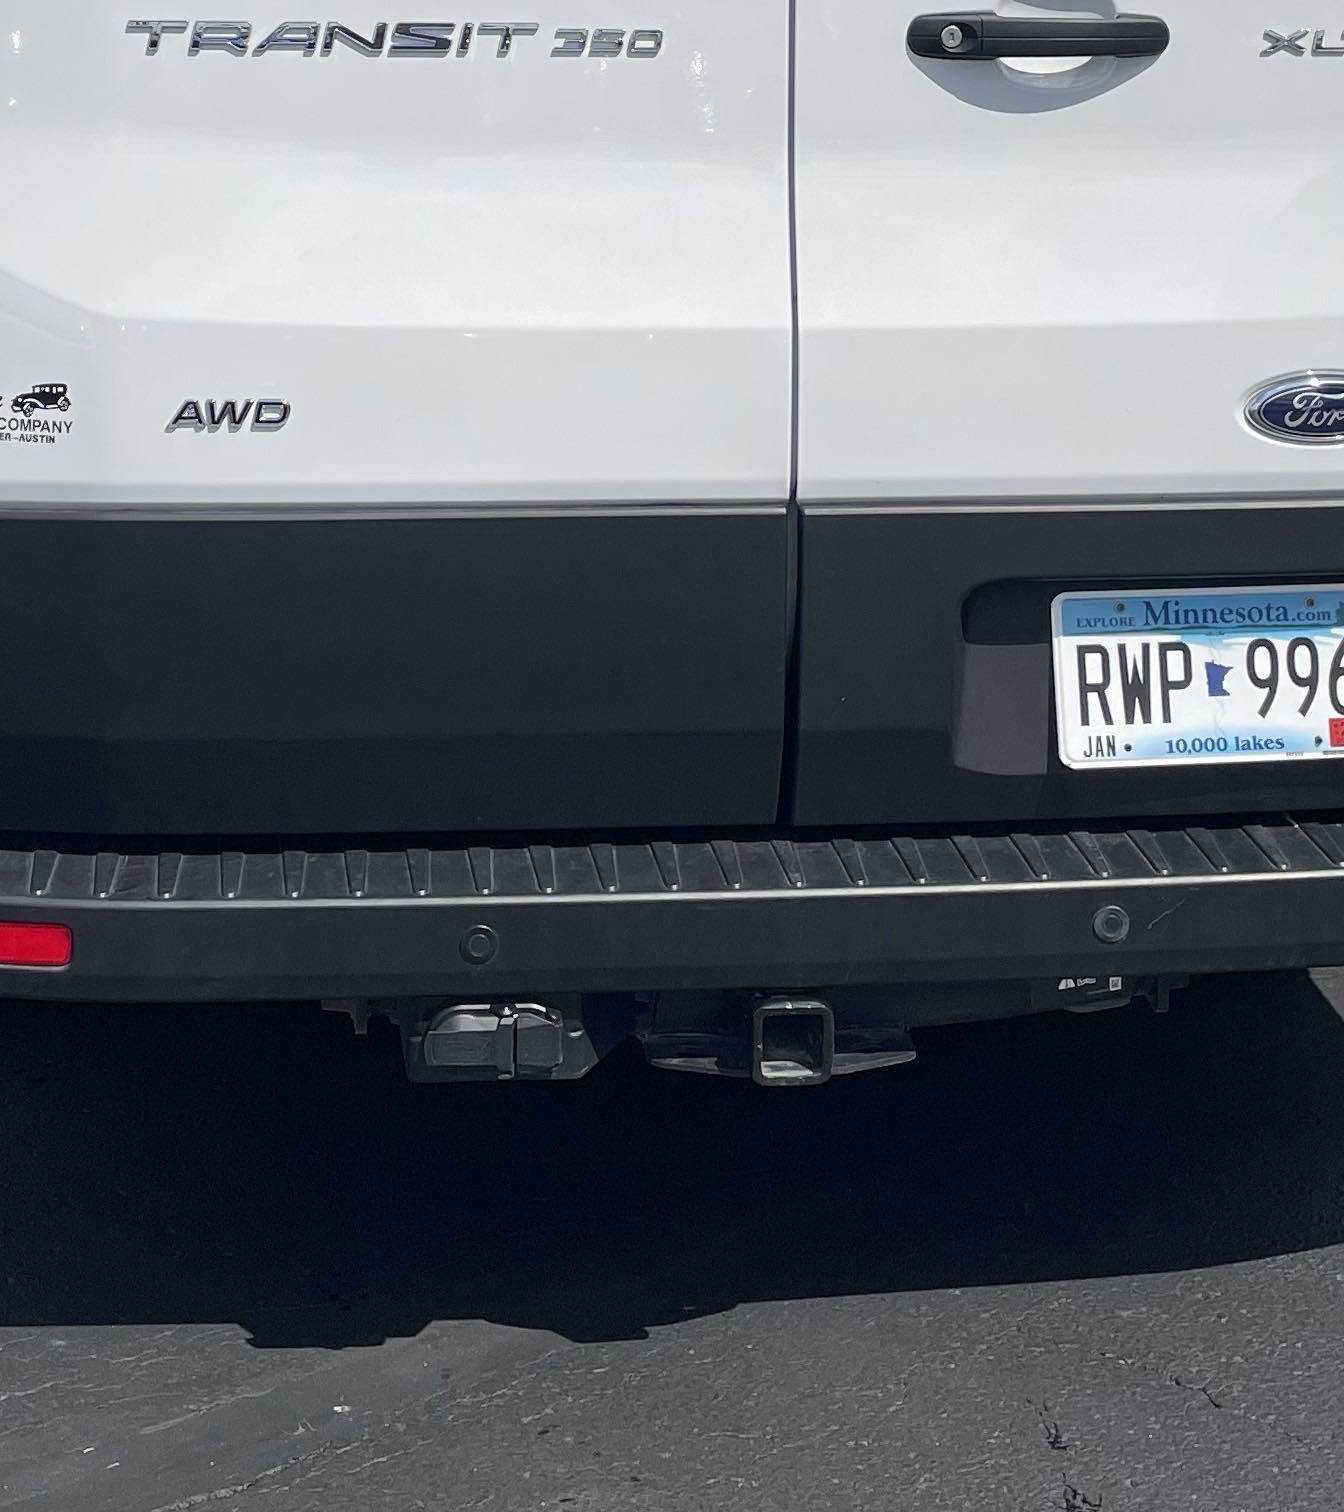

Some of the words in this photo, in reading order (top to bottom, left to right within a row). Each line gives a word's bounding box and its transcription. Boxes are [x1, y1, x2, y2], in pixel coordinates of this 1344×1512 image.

[125, 19, 540, 58] TRANSIT
[549, 28, 664, 58] 350
[164, 398, 291, 433] AWD
[1076, 616, 1137, 629] EXPLORE
[1142, 600, 1332, 626] Minnesota.com
[1076, 641, 1193, 727] RWP
[1083, 735, 1117, 758] JAN
[1165, 737, 1228, 756] 10,000
[1234, 735, 1285, 751] lakes
